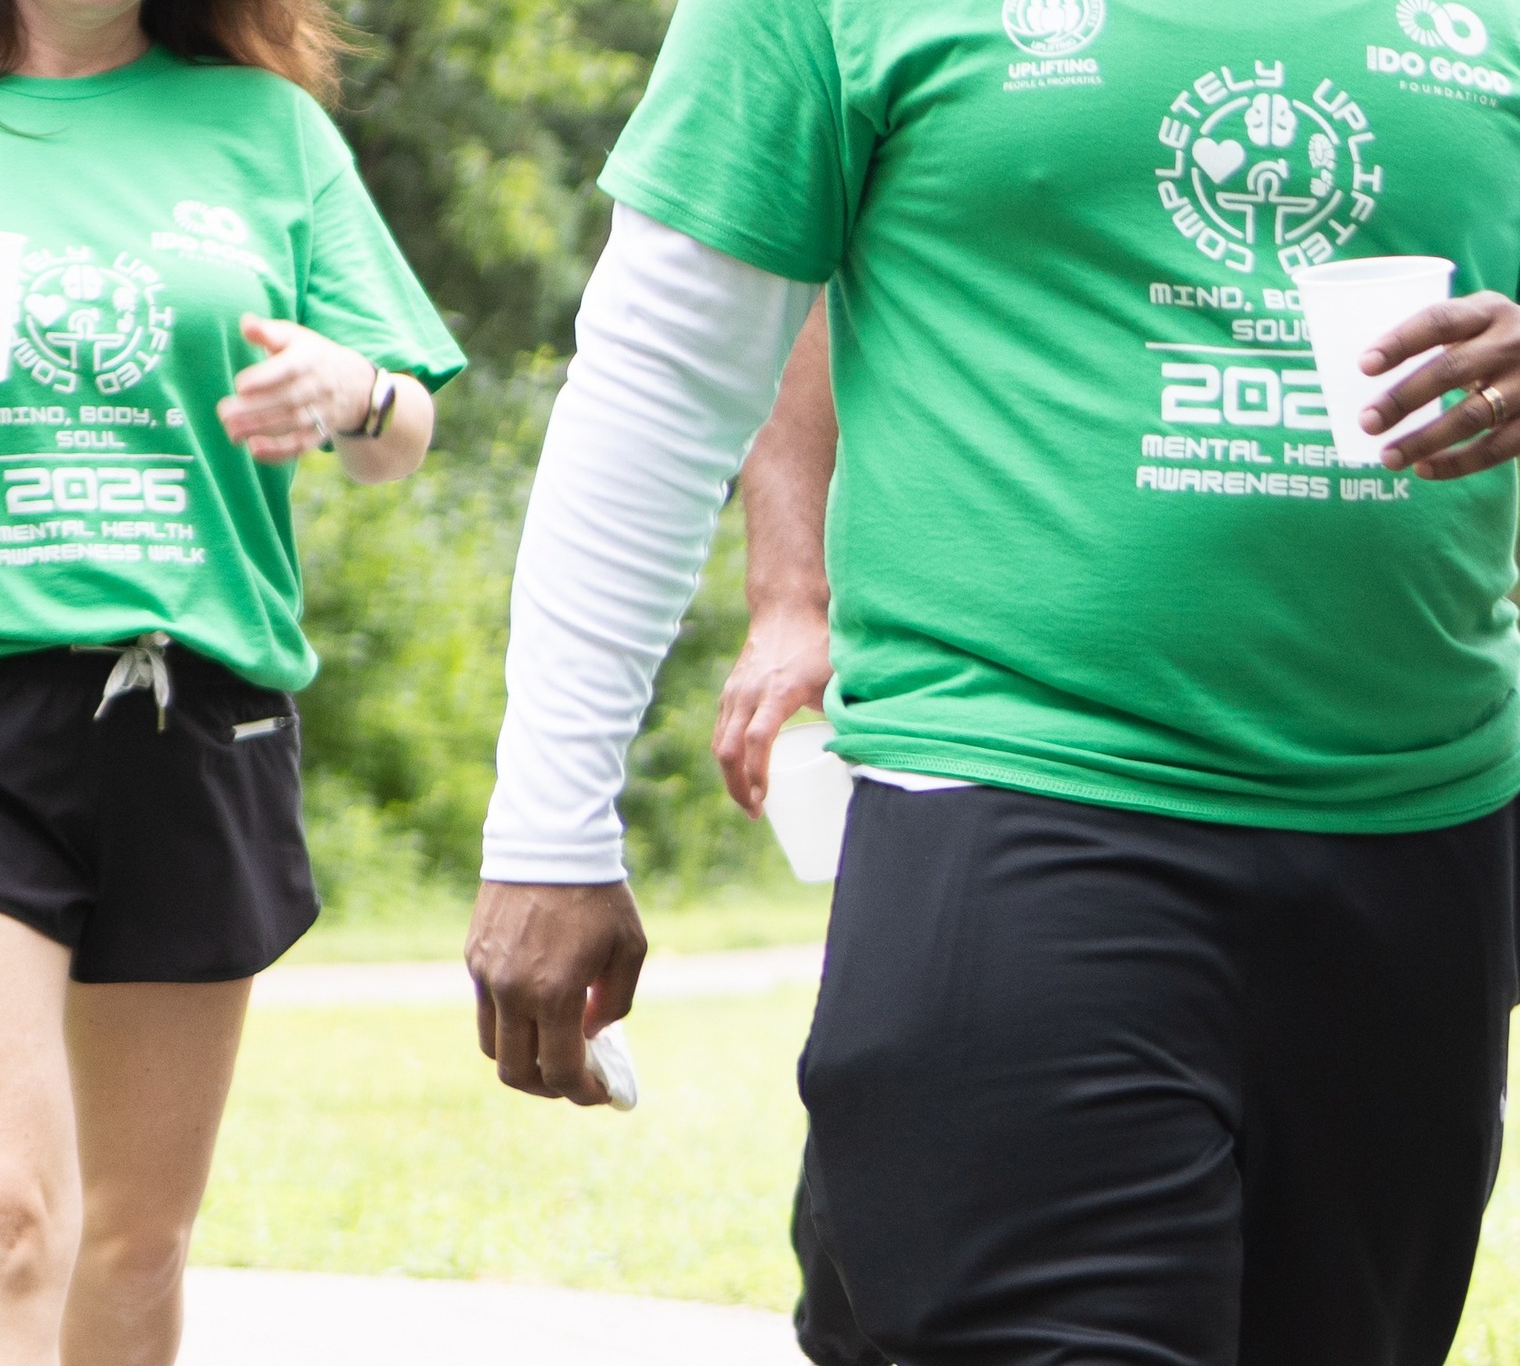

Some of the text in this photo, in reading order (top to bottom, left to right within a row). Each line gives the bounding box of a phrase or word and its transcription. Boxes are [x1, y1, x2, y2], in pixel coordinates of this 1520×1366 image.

[1007, 57, 1099, 79] UPLIFTING
[1429, 56, 1512, 95] GOOD
[1399, 80, 1498, 108] FOUNDATION
[1155, 59, 1383, 276] COMPLETELY UPLIFTED
[1149, 281, 1255, 313] MIND,
[1160, 362, 1333, 431] 202
[79, 405, 158, 427] BODY,
[55, 430, 127, 449] SOUL
[1141, 434, 1273, 463] MENTAL
[1136, 466, 1411, 502] AWARENESS WALK
[101, 520, 194, 541] HEALTH
[147, 545, 206, 565] WALK
